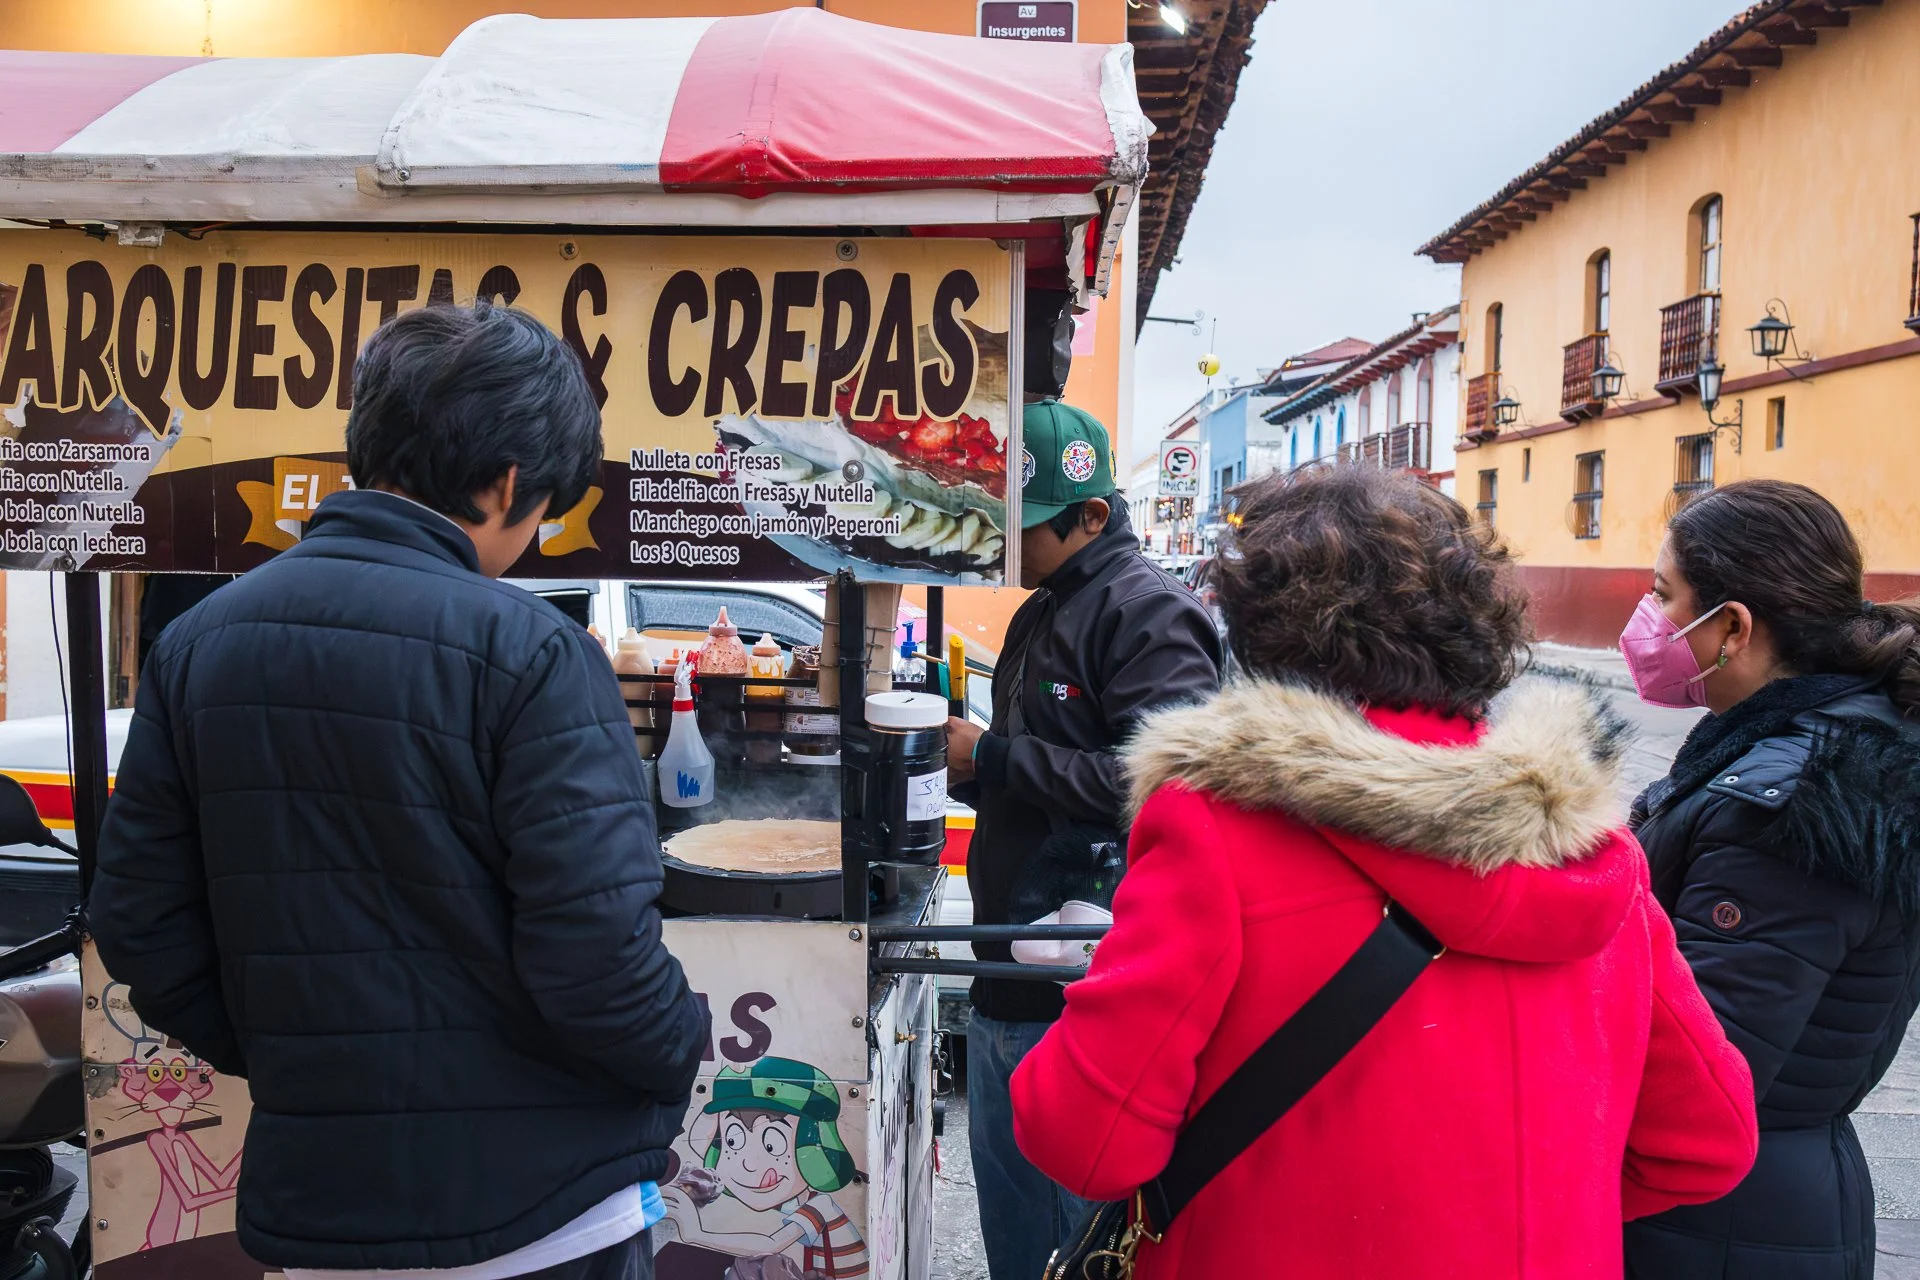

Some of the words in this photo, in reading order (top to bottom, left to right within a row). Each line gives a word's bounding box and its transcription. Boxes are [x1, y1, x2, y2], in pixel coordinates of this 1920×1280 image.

[1019, 6, 1036, 16] Av.
[988, 25, 1066, 39] Insurgentes
[647, 267, 980, 418] CREPAS
[27, 446, 57, 460] con
[60, 441, 150, 460] Zarsamora
[1068, 442, 1089, 451] OAKLAND
[631, 450, 690, 470] Nulleta
[695, 455, 724, 470] con
[729, 453, 781, 471] Fresas
[28, 477, 58, 490] con
[63, 471, 123, 491] Nutella
[281, 474, 321, 509] EL
[631, 480, 705, 501] Filadelfia
[710, 486, 739, 501] con
[744, 483, 795, 502] Fresas
[799, 487, 809, 507] y
[814, 482, 874, 503] Nutella
[6, 500, 43, 520] bola
[47, 506, 77, 521] con
[82, 502, 143, 522] Nutella
[631, 511, 717, 535] Manchego
[722, 516, 752, 533] con
[755, 513, 809, 538] jamón
[811, 519, 823, 537] y
[827, 515, 900, 538] Peperoni
[7, 530, 44, 550] bola
[49, 537, 78, 551] con
[83, 531, 144, 552] lechera
[631, 542, 659, 562] Los
[662, 543, 673, 562] 3
[677, 544, 739, 566] Quesos
